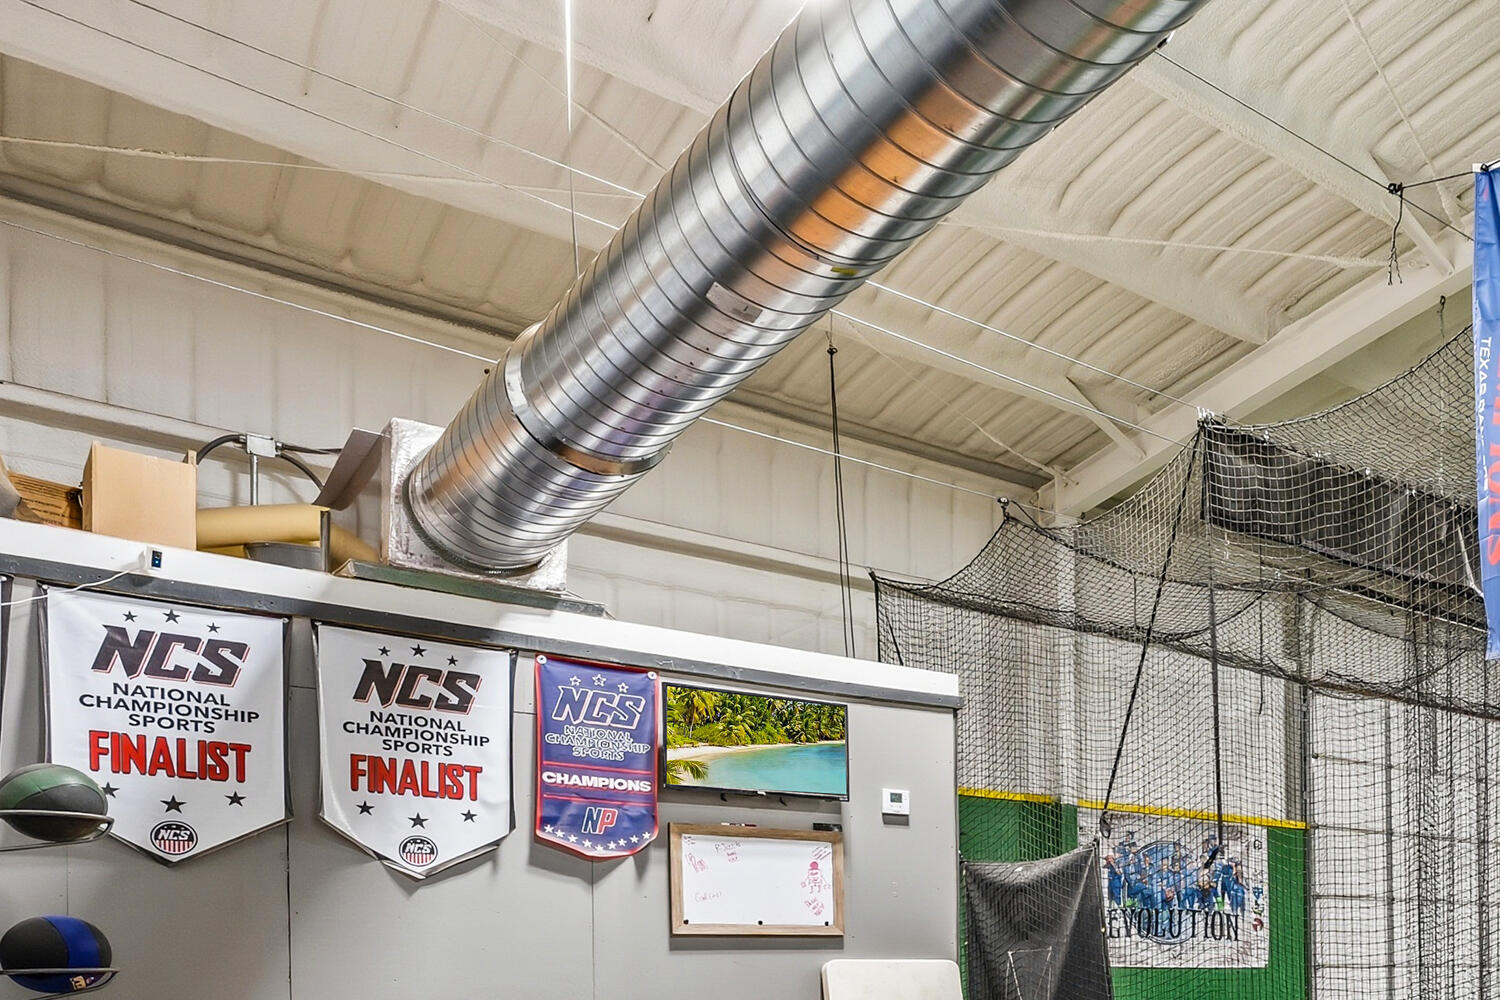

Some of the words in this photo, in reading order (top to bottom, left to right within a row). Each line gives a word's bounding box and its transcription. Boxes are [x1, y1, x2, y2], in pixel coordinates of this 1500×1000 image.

[91, 623, 251, 689] NCS
[112, 682, 231, 707] NATIONAL
[352, 657, 483, 716] NCS
[78, 693, 260, 723] CHAMPIONSHIP
[551, 684, 647, 730] NCS
[128, 713, 216, 734] SPORTS
[369, 710, 467, 733] NATIONAL
[563, 724, 634, 743] NATIONAL
[342, 721, 490, 747] CHAMPIONSHIP
[544, 732, 651, 754] CHAMPIONSHIP
[88, 729, 252, 784] FINALIST
[381, 738, 454, 757] SPORTS
[571, 746, 625, 762] SPORTS
[349, 753, 483, 802] FINALIST
[541, 771, 653, 793] CHAMPIONS
[581, 806, 618, 835] NP
[157, 828, 191, 841] NCS
[405, 841, 433, 854] NCS
